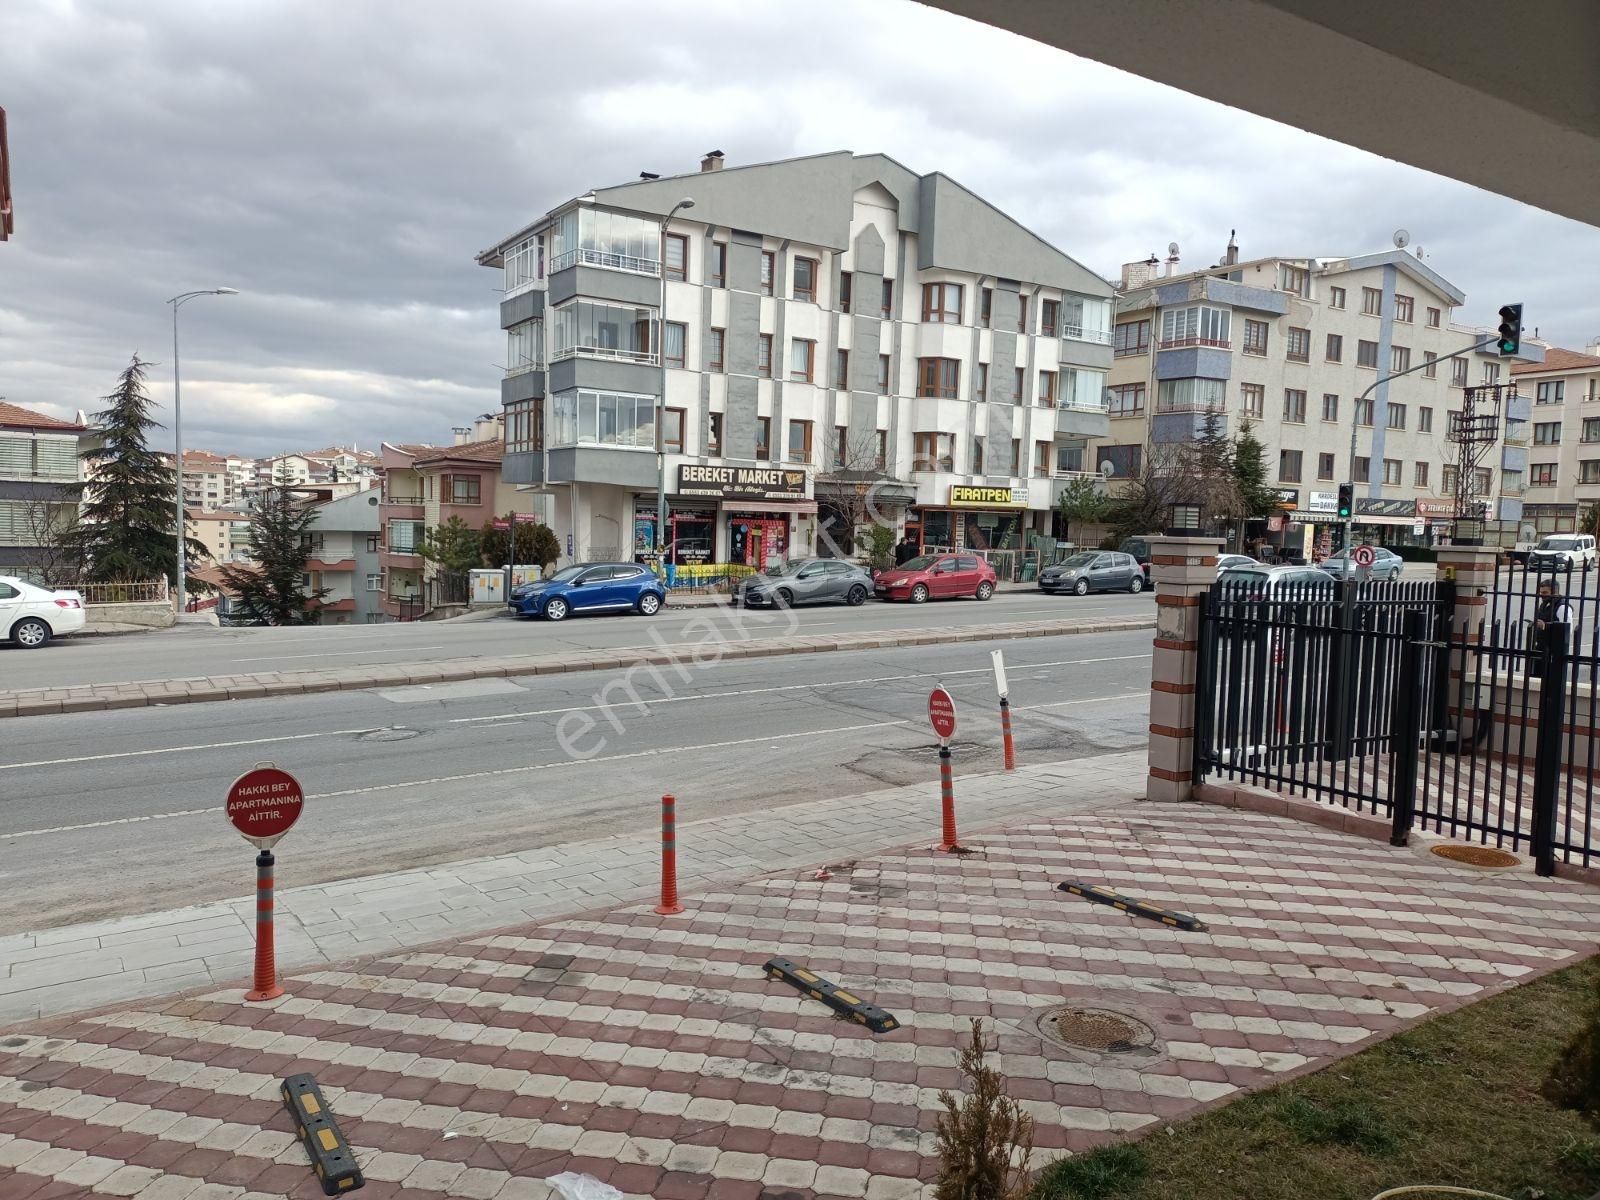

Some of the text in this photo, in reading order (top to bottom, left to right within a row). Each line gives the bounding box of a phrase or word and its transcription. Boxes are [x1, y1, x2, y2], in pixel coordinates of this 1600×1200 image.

[682, 466, 784, 485] BEREKET MARKET
[953, 487, 1010, 502] FIRATPEN
[238, 782, 291, 796] HAKKI BEY
[229, 794, 301, 811] APARTMANINA
